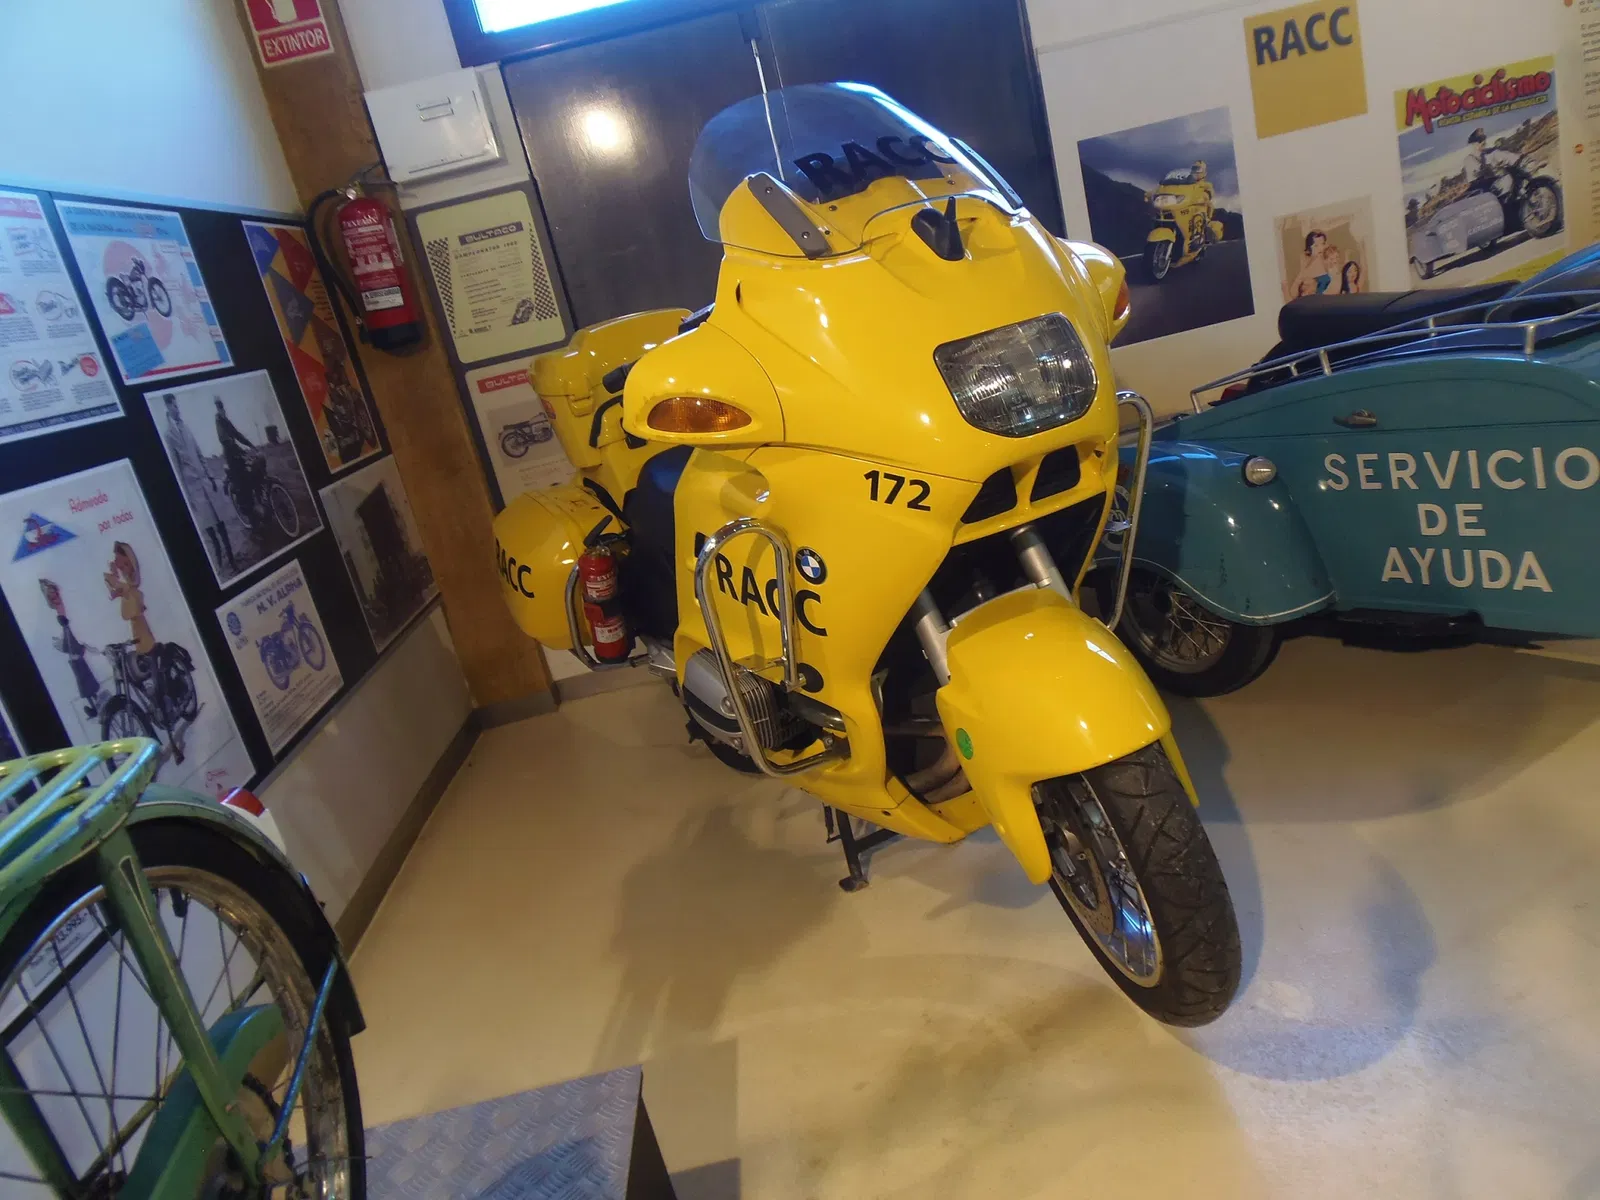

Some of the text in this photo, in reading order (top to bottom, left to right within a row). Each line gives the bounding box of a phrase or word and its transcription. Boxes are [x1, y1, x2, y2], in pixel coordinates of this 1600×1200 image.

[263, 27, 326, 57] EXTINTOR
[1253, 6, 1353, 66] RACC
[1405, 68, 1552, 134] Motociclismo
[793, 135, 958, 196] RACC
[465, 224, 517, 243] BULTACO
[864, 469, 931, 511] 172
[1324, 447, 1600, 491] SERVICIO
[1417, 503, 1486, 537] DE
[1381, 547, 1553, 592] AYUDA
[715, 552, 828, 637] RACC
